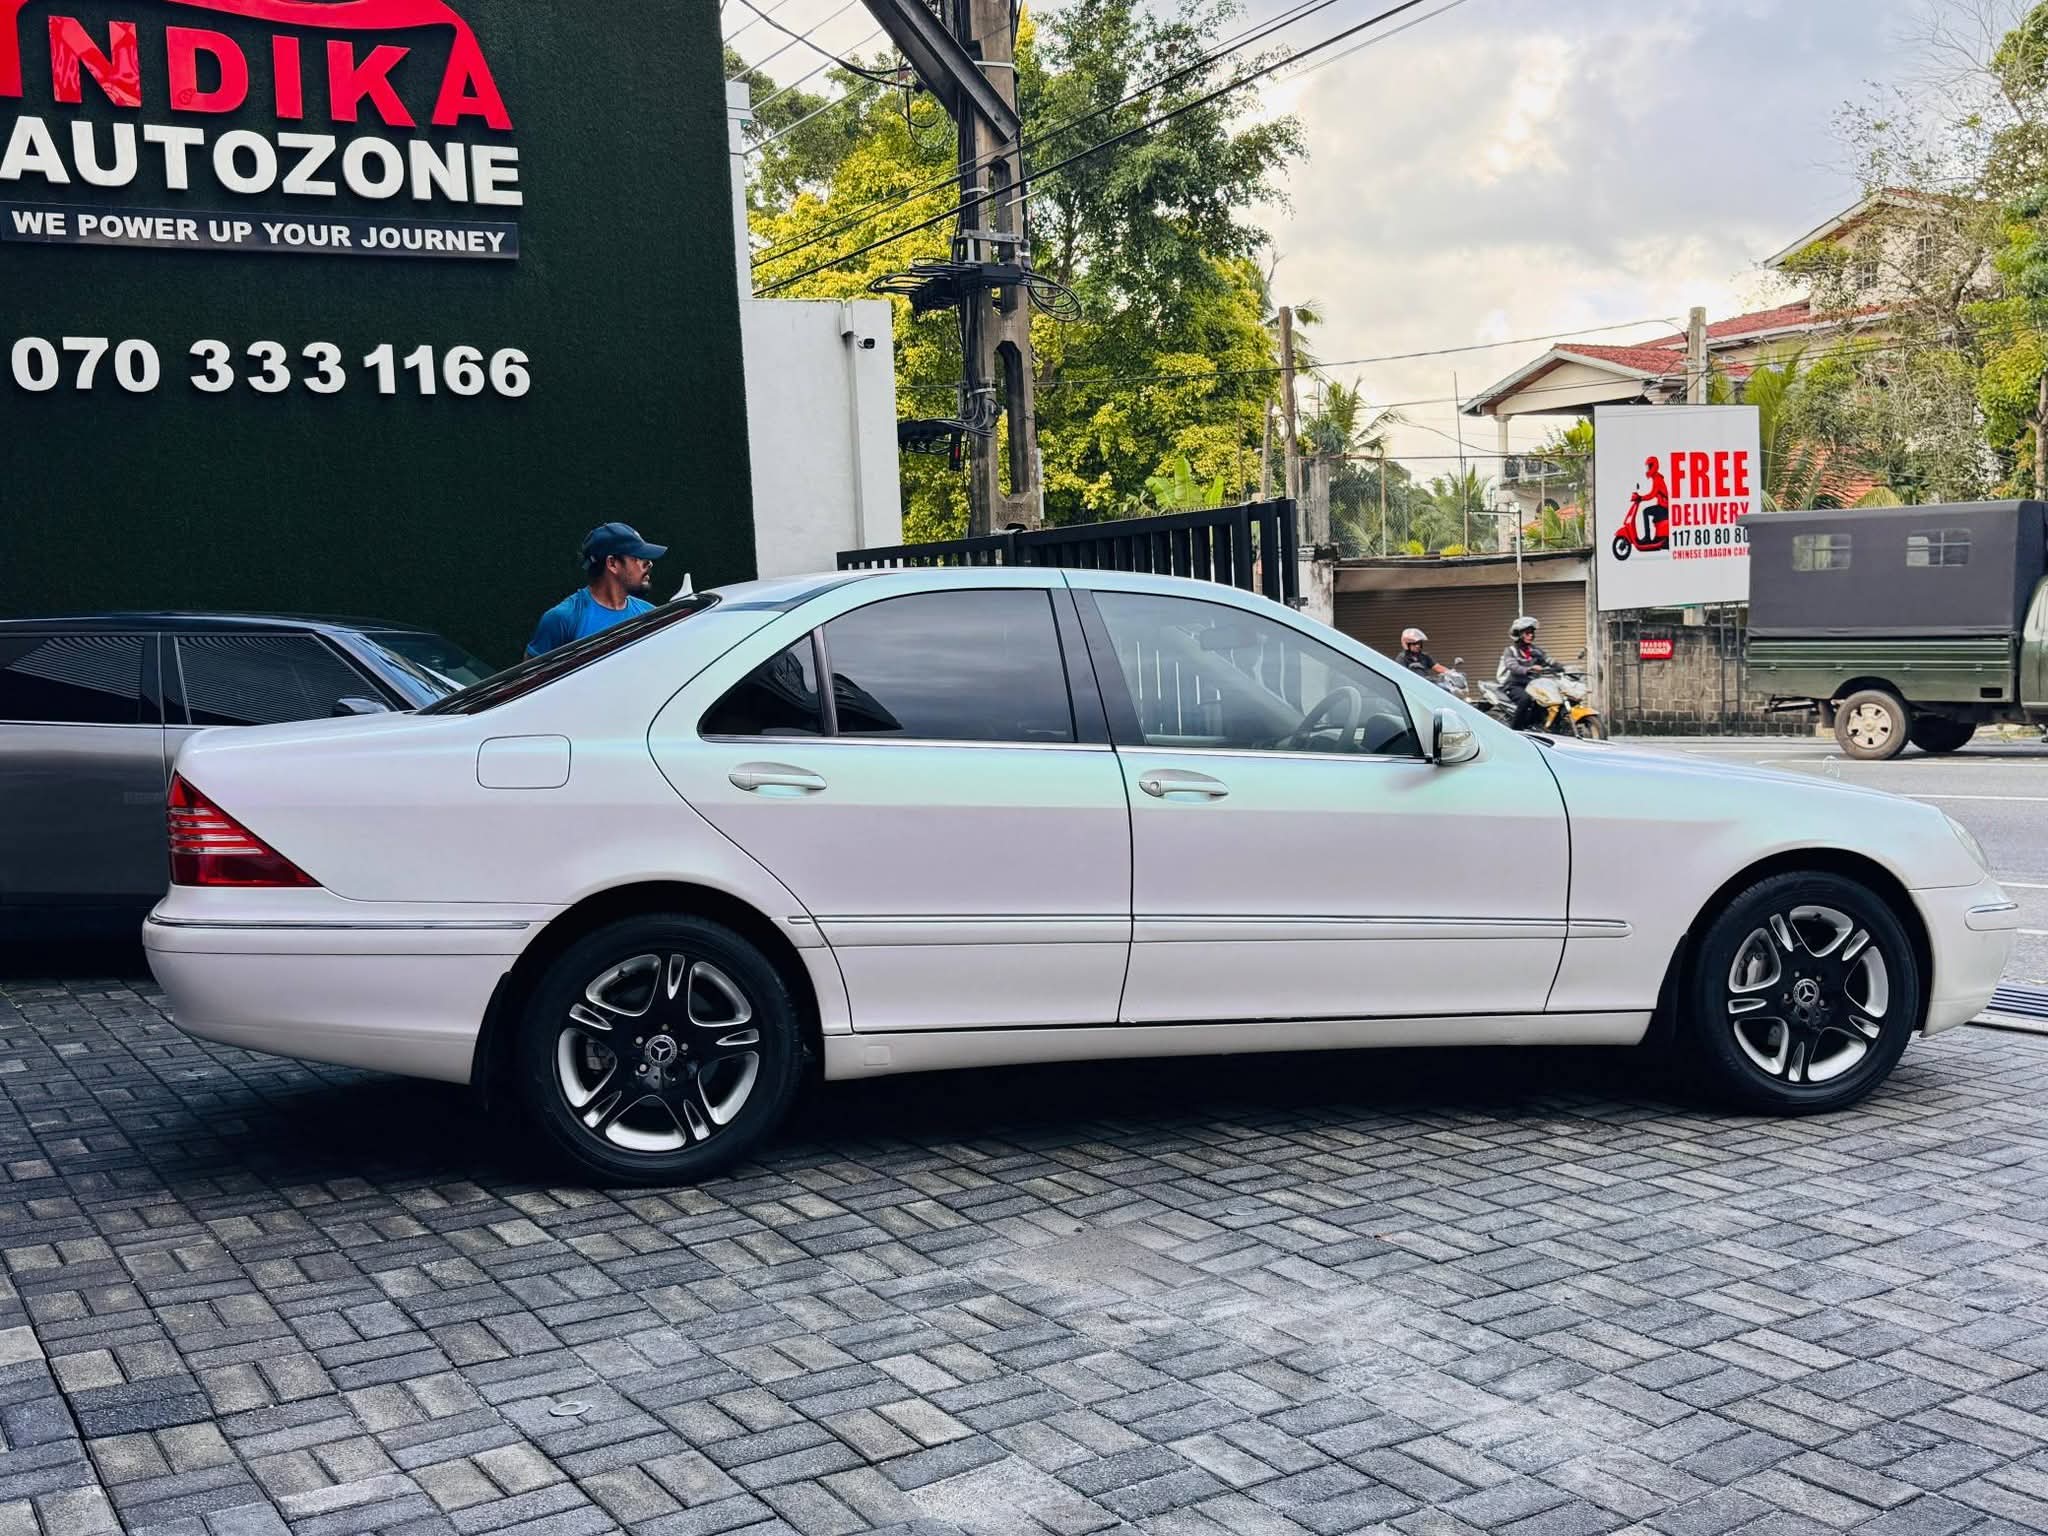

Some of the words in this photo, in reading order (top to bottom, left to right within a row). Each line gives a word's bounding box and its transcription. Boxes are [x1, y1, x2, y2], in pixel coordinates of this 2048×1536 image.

[0, 115, 523, 206] AUTOZONE
[11, 211, 66, 236] WE
[77, 214, 199, 242] POWER
[209, 220, 253, 244] UP
[261, 222, 352, 248] YOUR
[360, 226, 506, 253] JOURNEY
[11, 336, 160, 392] 070
[189, 339, 347, 394] 333
[362, 343, 531, 397] 1166
[1670, 451, 1750, 499] FREE
[1672, 529, 1691, 547] 117
[1694, 528, 1711, 546] 80
[1714, 527, 1731, 545] 80
[1672, 548, 1703, 560] CHINESE
[1704, 547, 1732, 559] DRAGON
